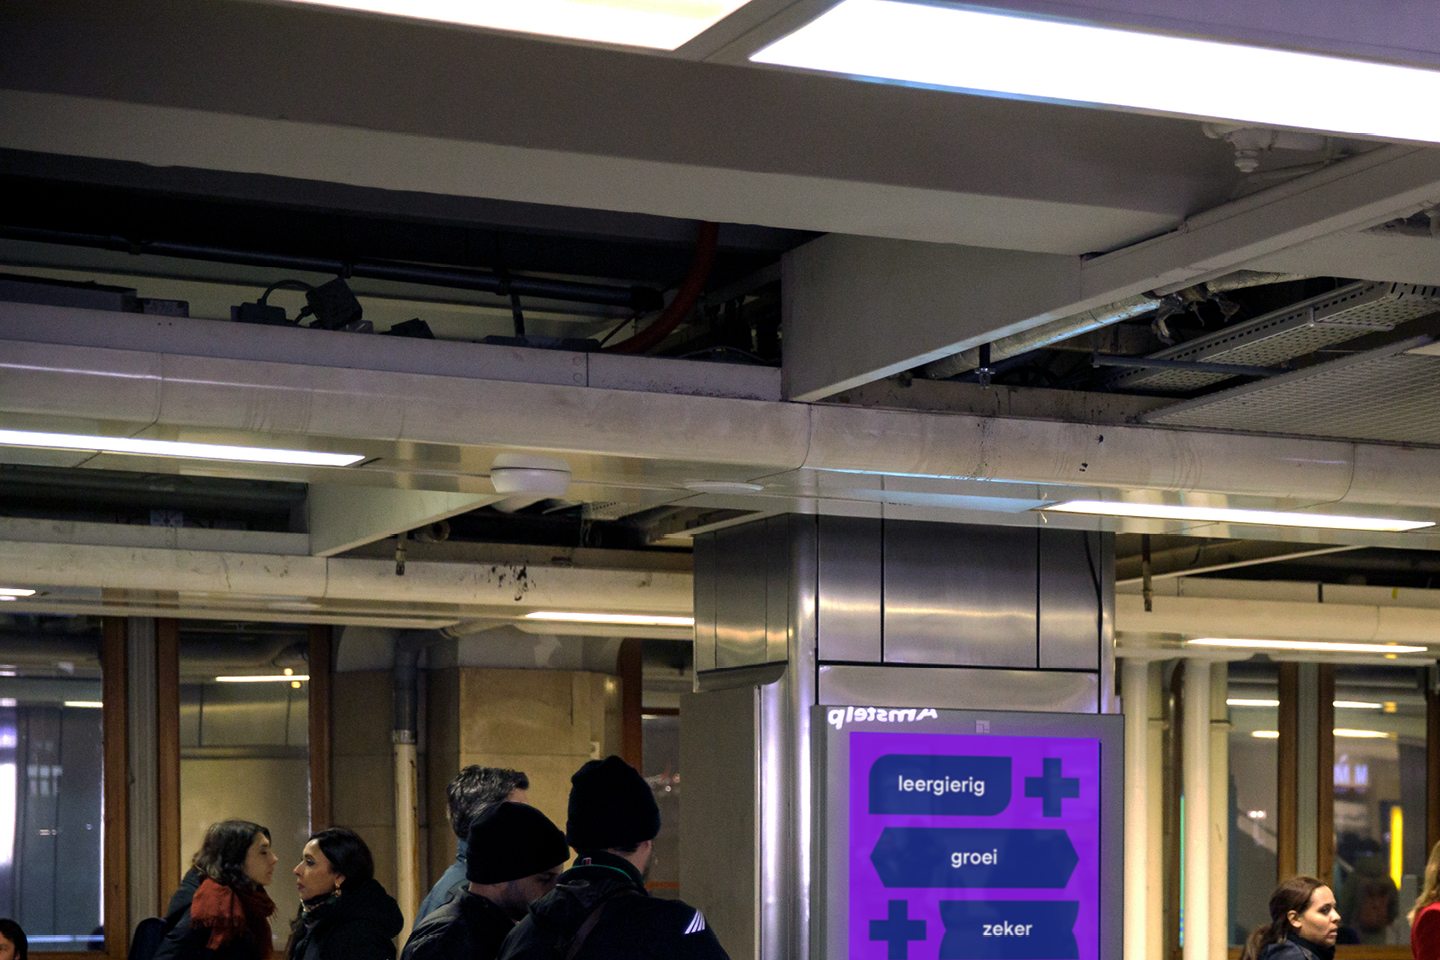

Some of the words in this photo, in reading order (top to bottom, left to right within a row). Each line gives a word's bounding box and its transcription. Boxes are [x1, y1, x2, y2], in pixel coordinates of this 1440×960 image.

[898, 775, 985, 796] leergierig
[950, 848, 998, 869] groei
[982, 920, 1033, 936] zeker
